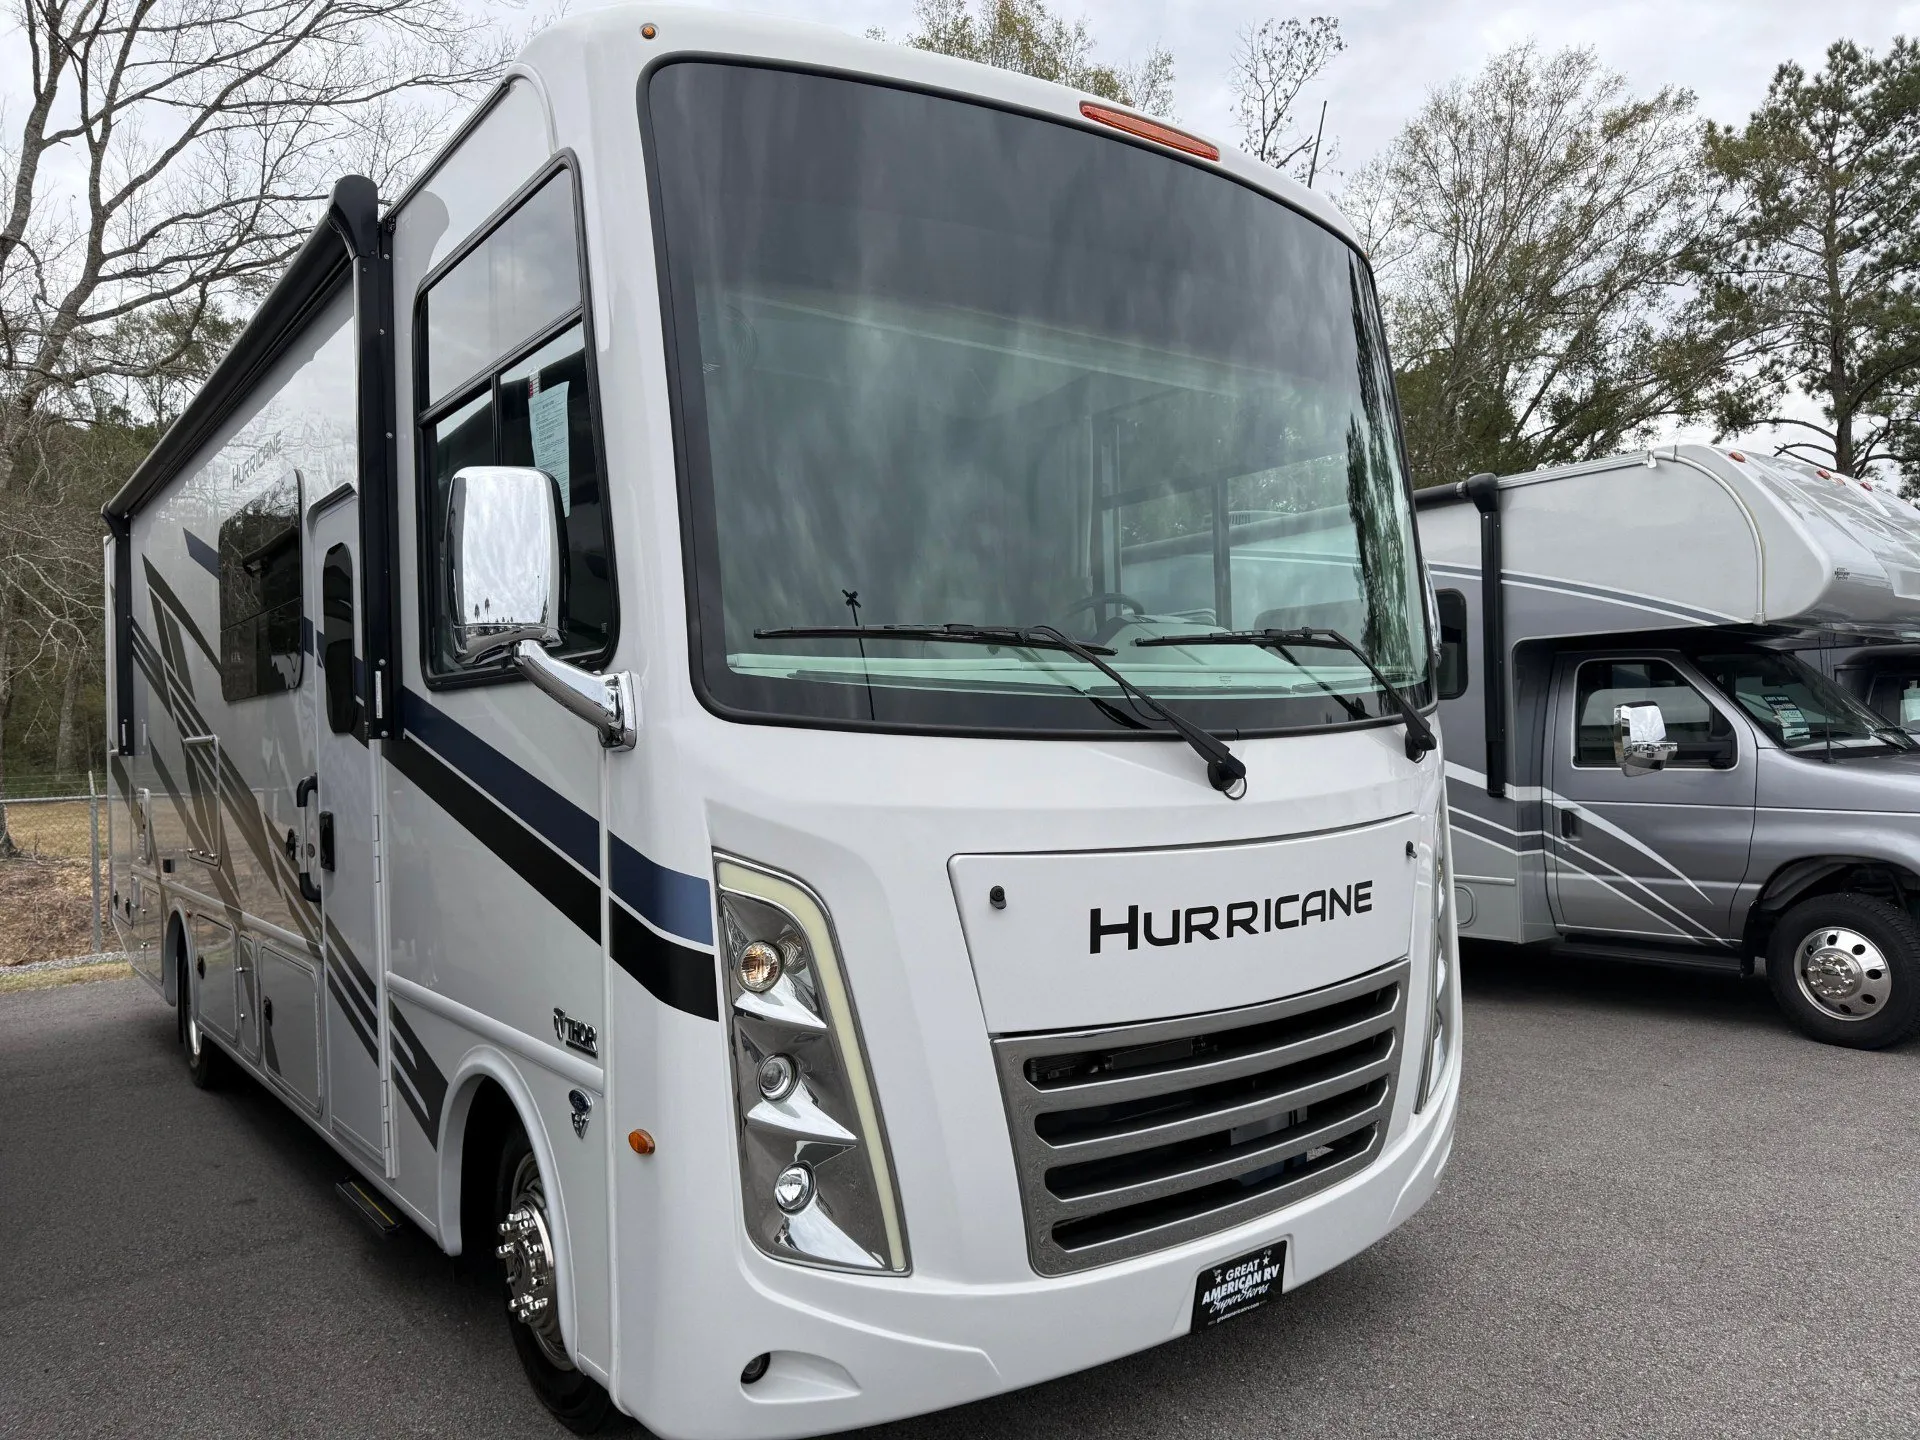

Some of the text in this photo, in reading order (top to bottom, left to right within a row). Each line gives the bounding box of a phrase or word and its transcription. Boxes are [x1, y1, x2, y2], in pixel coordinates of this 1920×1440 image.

[232, 430, 282, 491] HURRICANE
[1089, 880, 1373, 955] HURRICANE
[564, 1016, 598, 1051] THOR
[1201, 1263, 1280, 1306] AMERICAN RV
[1225, 1259, 1260, 1281] GREAT
